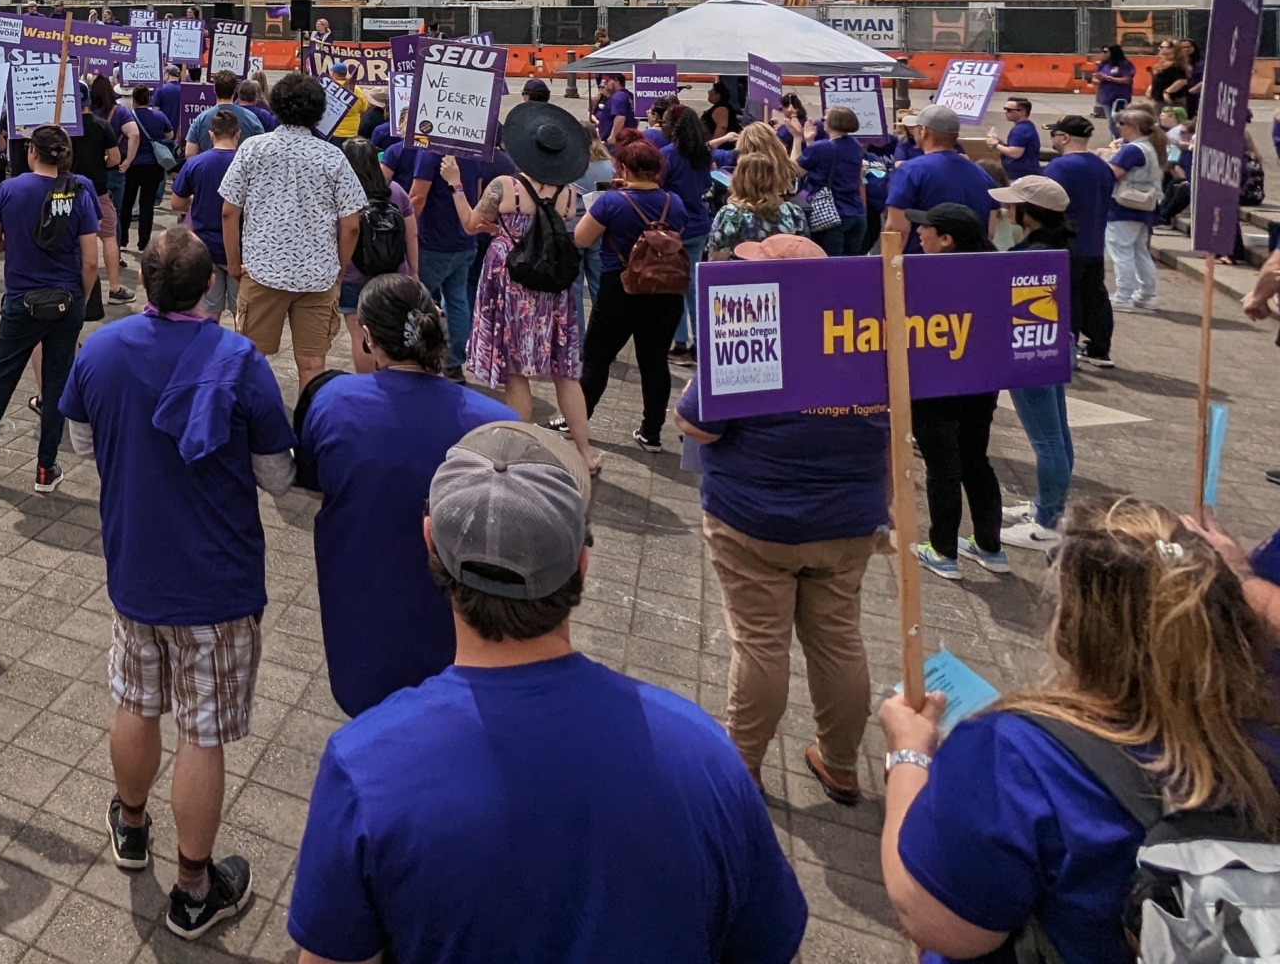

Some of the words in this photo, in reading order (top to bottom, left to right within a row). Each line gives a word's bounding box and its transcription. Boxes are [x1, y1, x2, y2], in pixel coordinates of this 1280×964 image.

[131, 10, 155, 19] SEIU
[172, 20, 202, 30] SEIU
[215, 22, 248, 35] SEIU
[824, 18, 894, 32] FMAN
[109, 44, 132, 52] SEIU
[331, 46, 361, 58] Make
[364, 48, 393, 58] Oreg
[408, 44, 414, 54] A
[88, 57, 107, 65] NION
[425, 44, 497, 69] SEIU
[314, 52, 394, 82] WOR
[397, 59, 417, 72] STRO
[949, 61, 999, 76] SEIU
[750, 63, 782, 83] SUSTAINABLE
[394, 75, 414, 87] SE
[426, 71, 450, 89] WE
[636, 76, 675, 84] SUSTAINABLE
[750, 75, 782, 95] WORKLOADS
[825, 77, 875, 92] SEIU
[948, 77, 976, 89] FAIR
[200, 92, 206, 100] A
[320, 77, 354, 105] SEIU
[636, 90, 676, 98] WORKLOADS
[942, 89, 985, 101] CONTRACT
[437, 89, 487, 108] DESERVE
[1216, 81, 1239, 127] SAFE
[184, 104, 214, 113] STRON
[419, 102, 428, 116] A
[436, 106, 464, 122] FAIR
[944, 100, 975, 111] NOW
[438, 122, 486, 140] CONTRACT
[1011, 276, 1040, 286] LOCAL
[1041, 275, 1057, 285] 503
[715, 330, 727, 339] We
[728, 328, 748, 338] Make
[750, 327, 778, 338] Oregon
[823, 309, 972, 360] Haney
[1011, 323, 1058, 348] SEIU
[715, 337, 779, 366] WORK
[715, 374, 761, 387] BARGAINING
[763, 372, 779, 383] 2023
